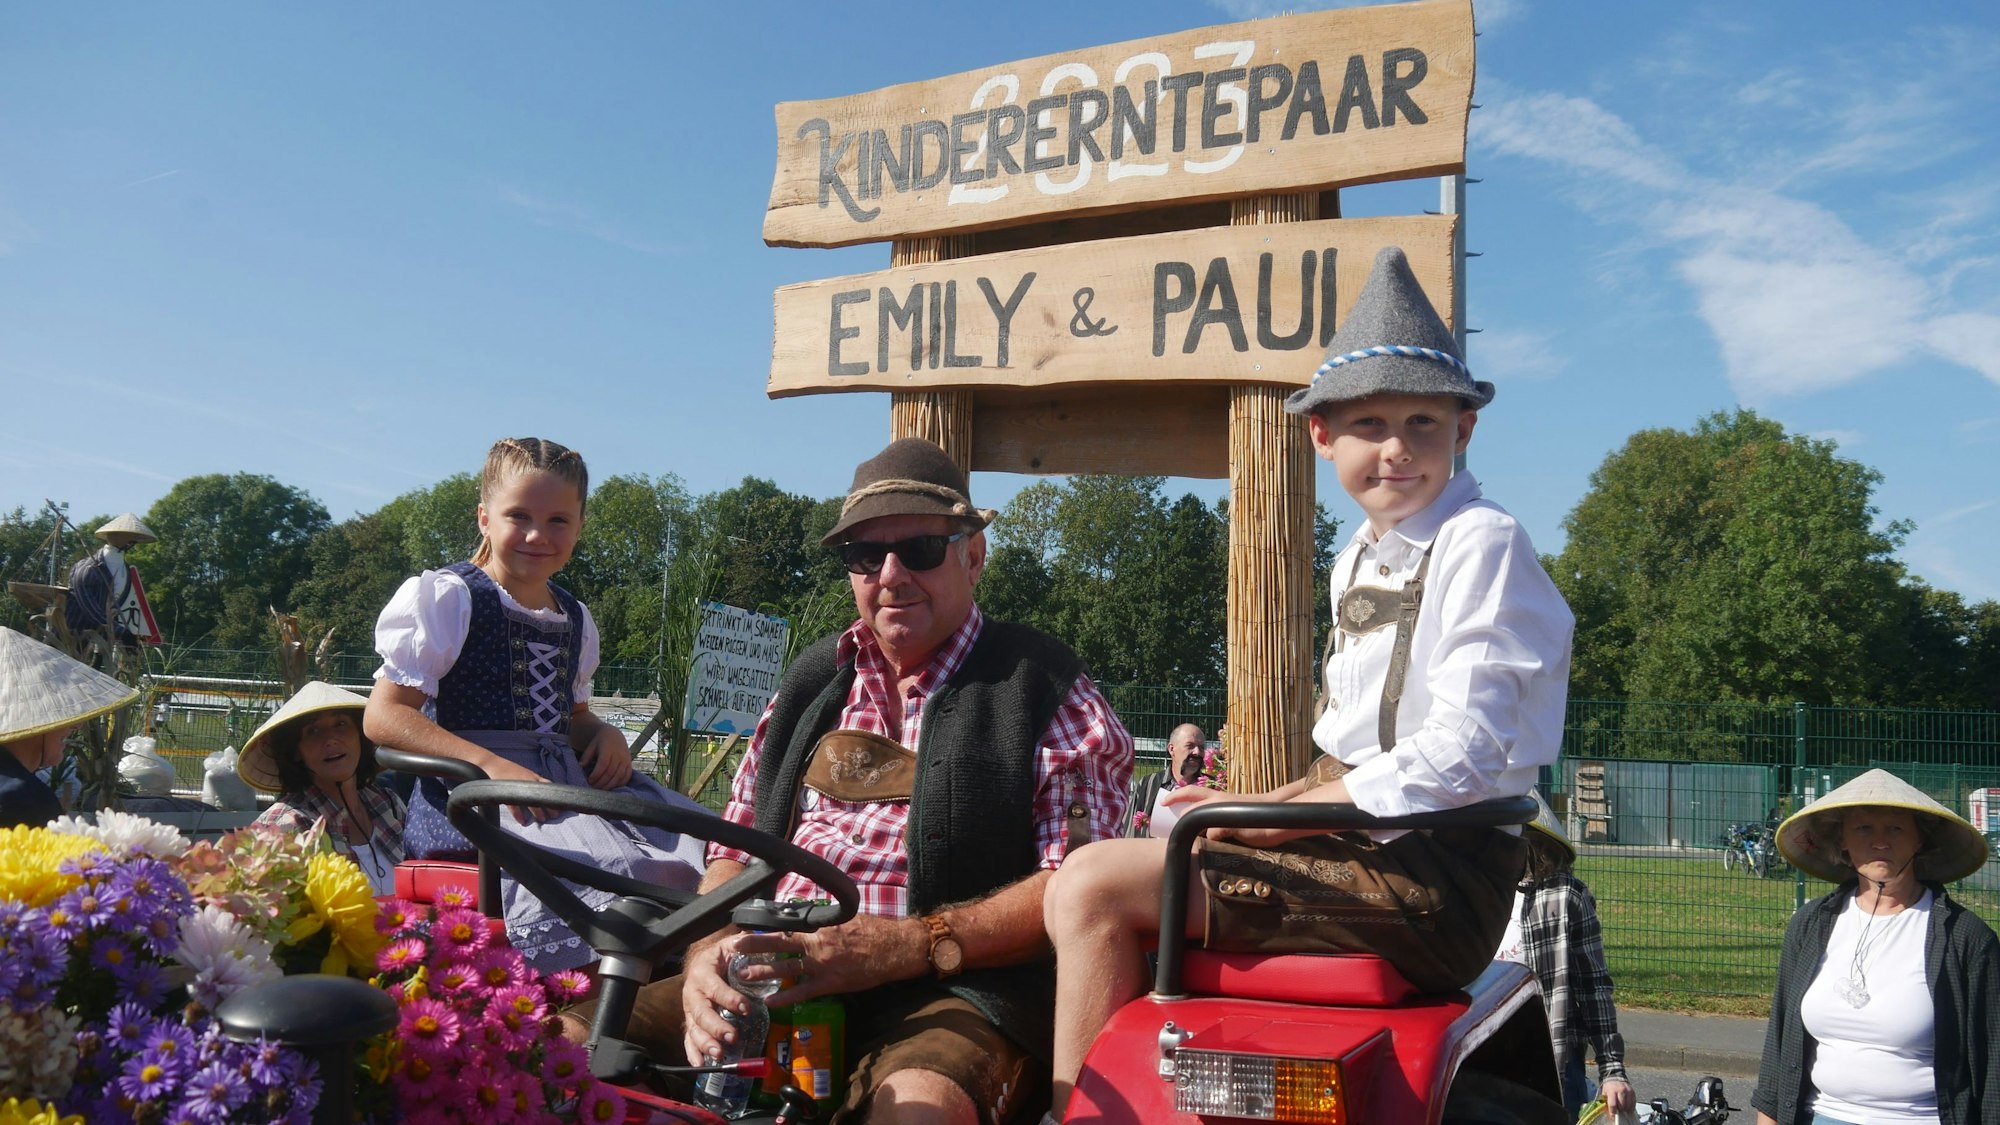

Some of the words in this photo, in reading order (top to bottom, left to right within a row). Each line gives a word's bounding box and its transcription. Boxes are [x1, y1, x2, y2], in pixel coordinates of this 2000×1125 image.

[797, 47, 1429, 223] KINDERERNTEPAAR
[948, 41, 1255, 206] 2023
[828, 272, 1037, 376] EMILY
[1069, 286, 1118, 338] &
[705, 662, 725, 681] WIRD
[728, 666, 775, 692] UMGESATTELT
[755, 620, 784, 639] SOMMER
